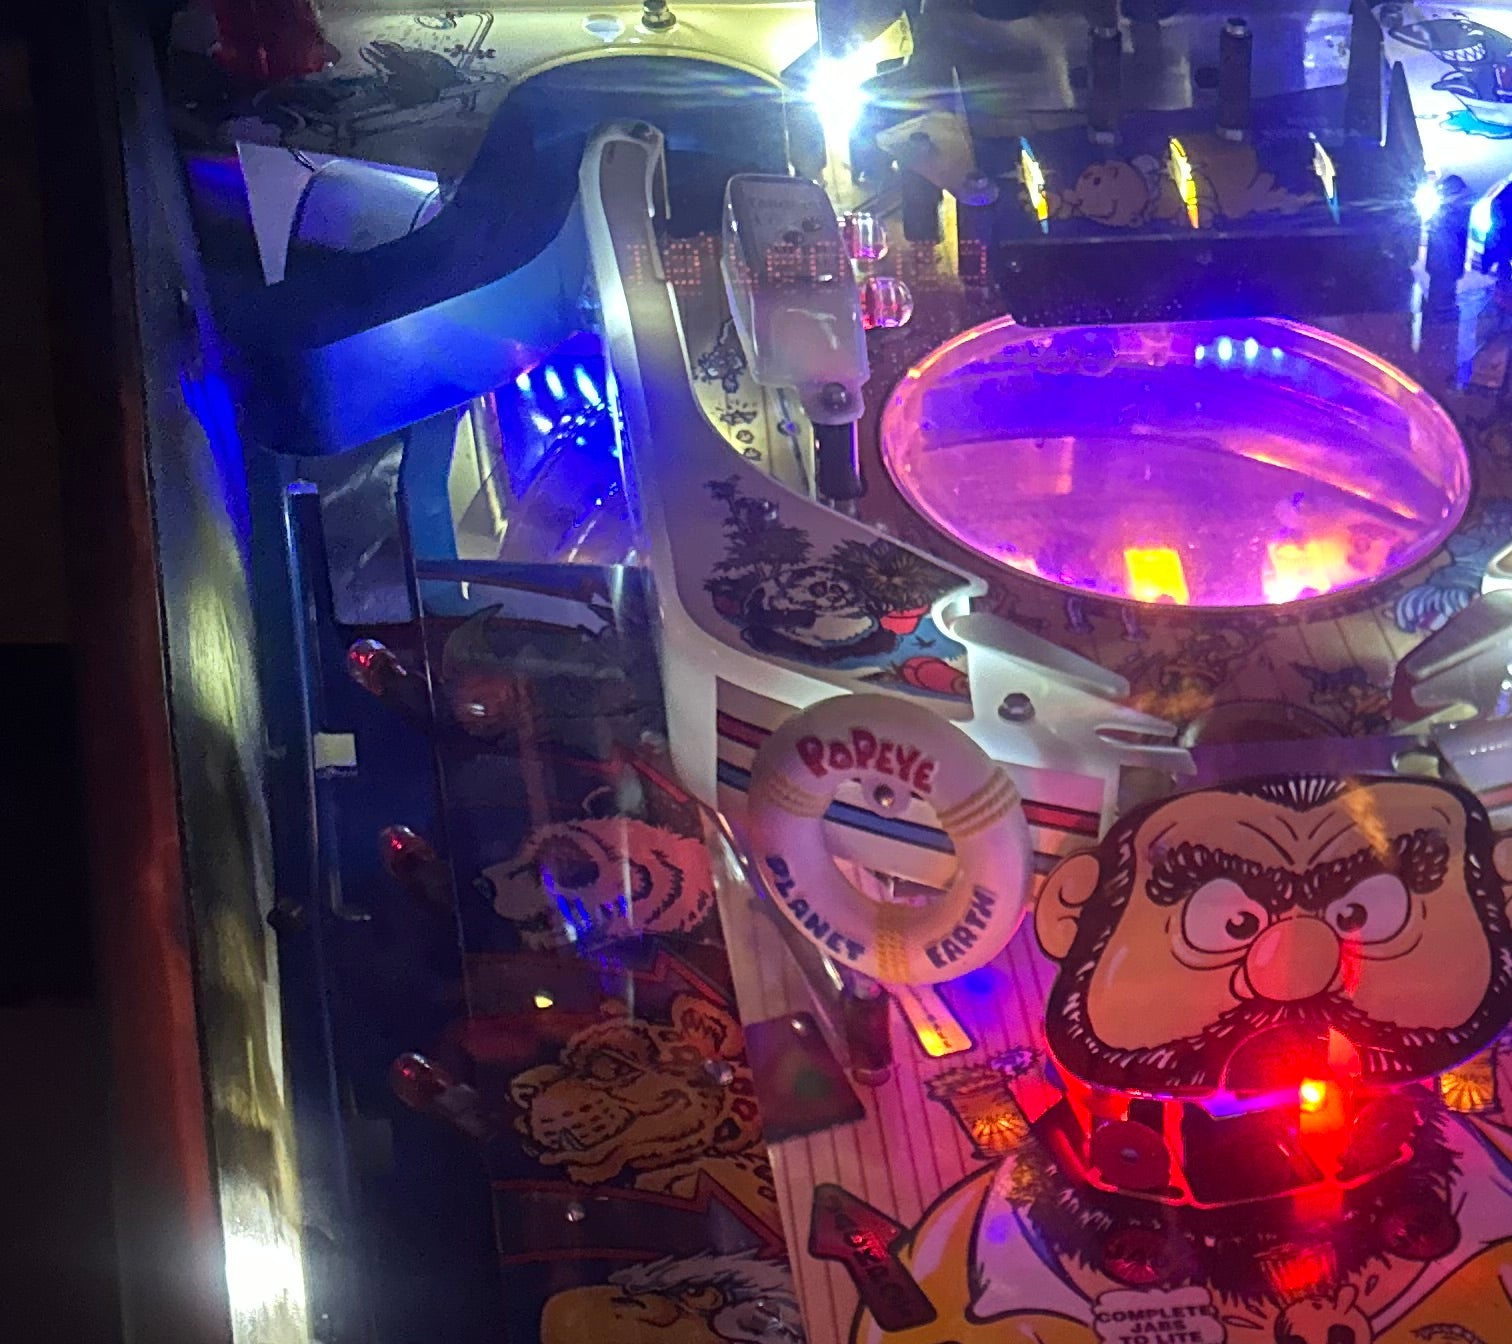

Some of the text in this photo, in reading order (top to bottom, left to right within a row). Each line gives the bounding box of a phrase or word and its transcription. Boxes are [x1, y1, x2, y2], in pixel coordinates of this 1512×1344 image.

[795, 727, 934, 794] POPEYE
[765, 855, 866, 961] PLANET
[925, 885, 997, 969] EARTH
[1096, 1306, 1210, 1323] COMPLETE
[1131, 1320, 1187, 1334] JABS
[1155, 1331, 1202, 1344] LITE
